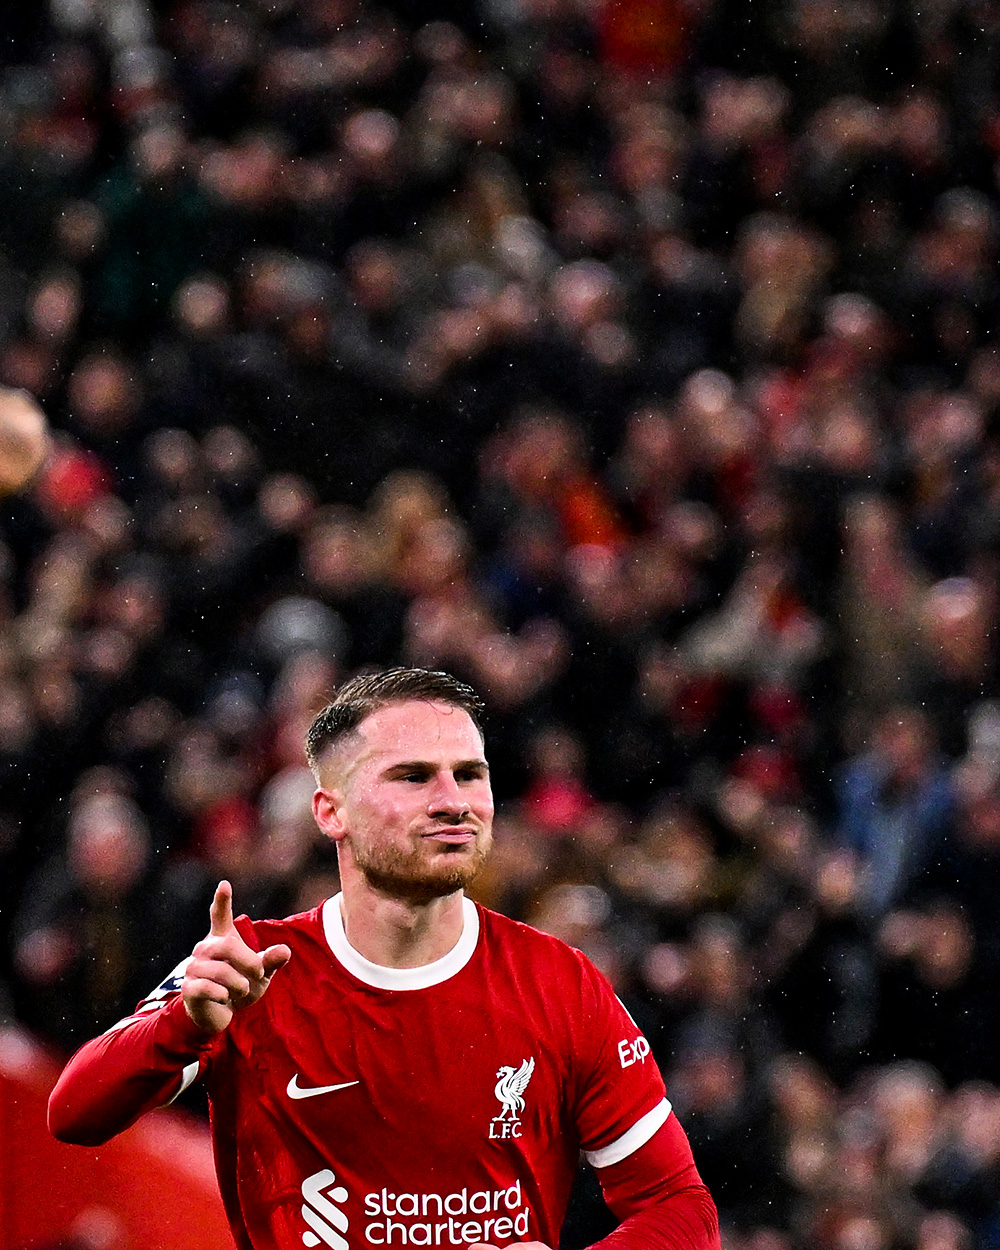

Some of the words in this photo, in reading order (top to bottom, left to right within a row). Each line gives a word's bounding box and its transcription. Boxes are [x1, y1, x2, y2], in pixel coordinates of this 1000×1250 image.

[617, 1035, 651, 1069] Exp
[364, 1178, 522, 1217] standard
[364, 1206, 530, 1246] chartered
